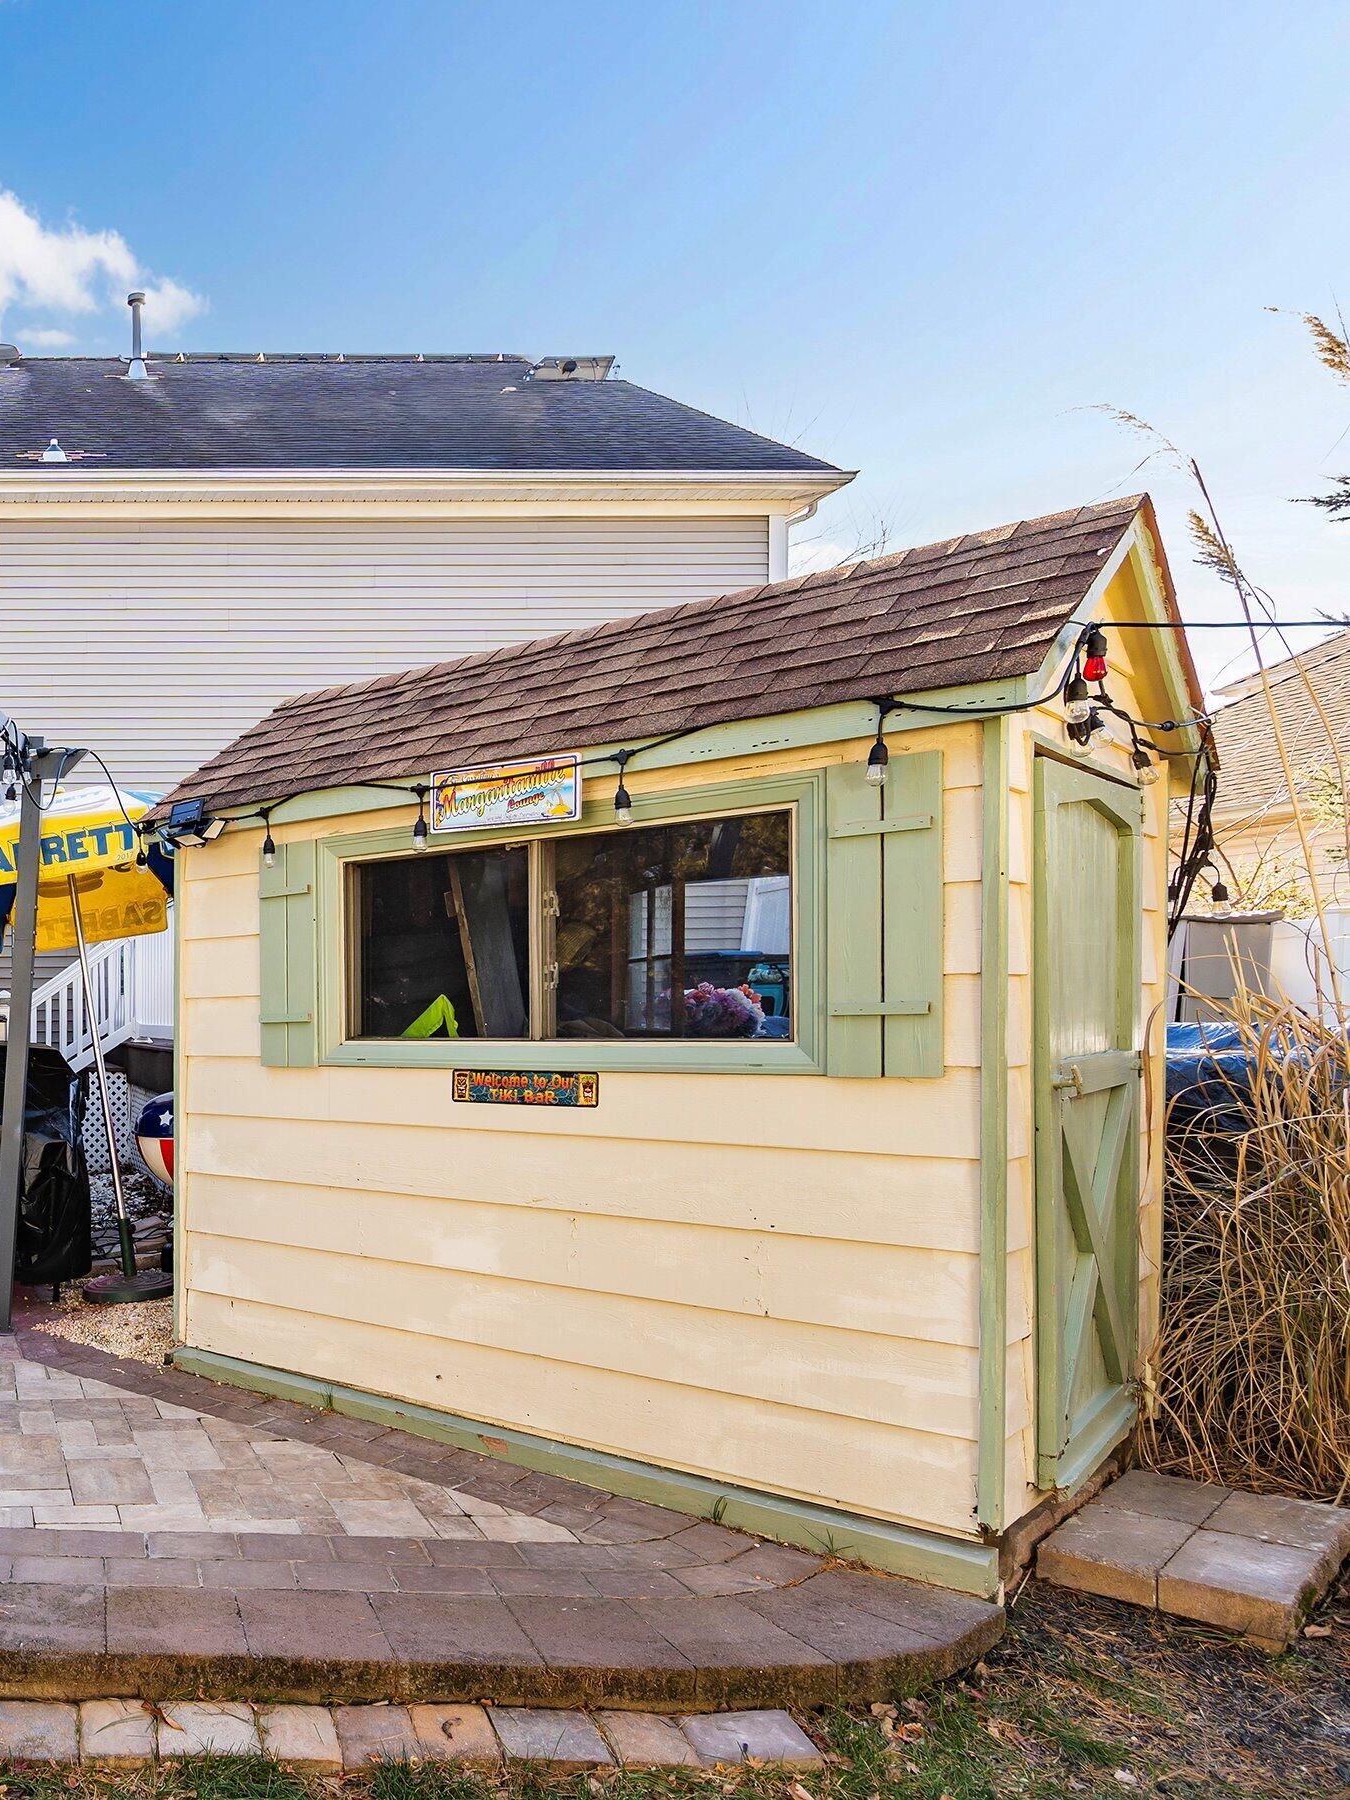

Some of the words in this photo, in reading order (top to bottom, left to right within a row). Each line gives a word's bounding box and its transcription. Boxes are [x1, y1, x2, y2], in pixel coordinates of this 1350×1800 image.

[508, 791, 545, 812] Lounge
[473, 1072, 529, 1087] Welcome
[534, 1075, 546, 1088] to
[552, 1074, 575, 1089] Our
